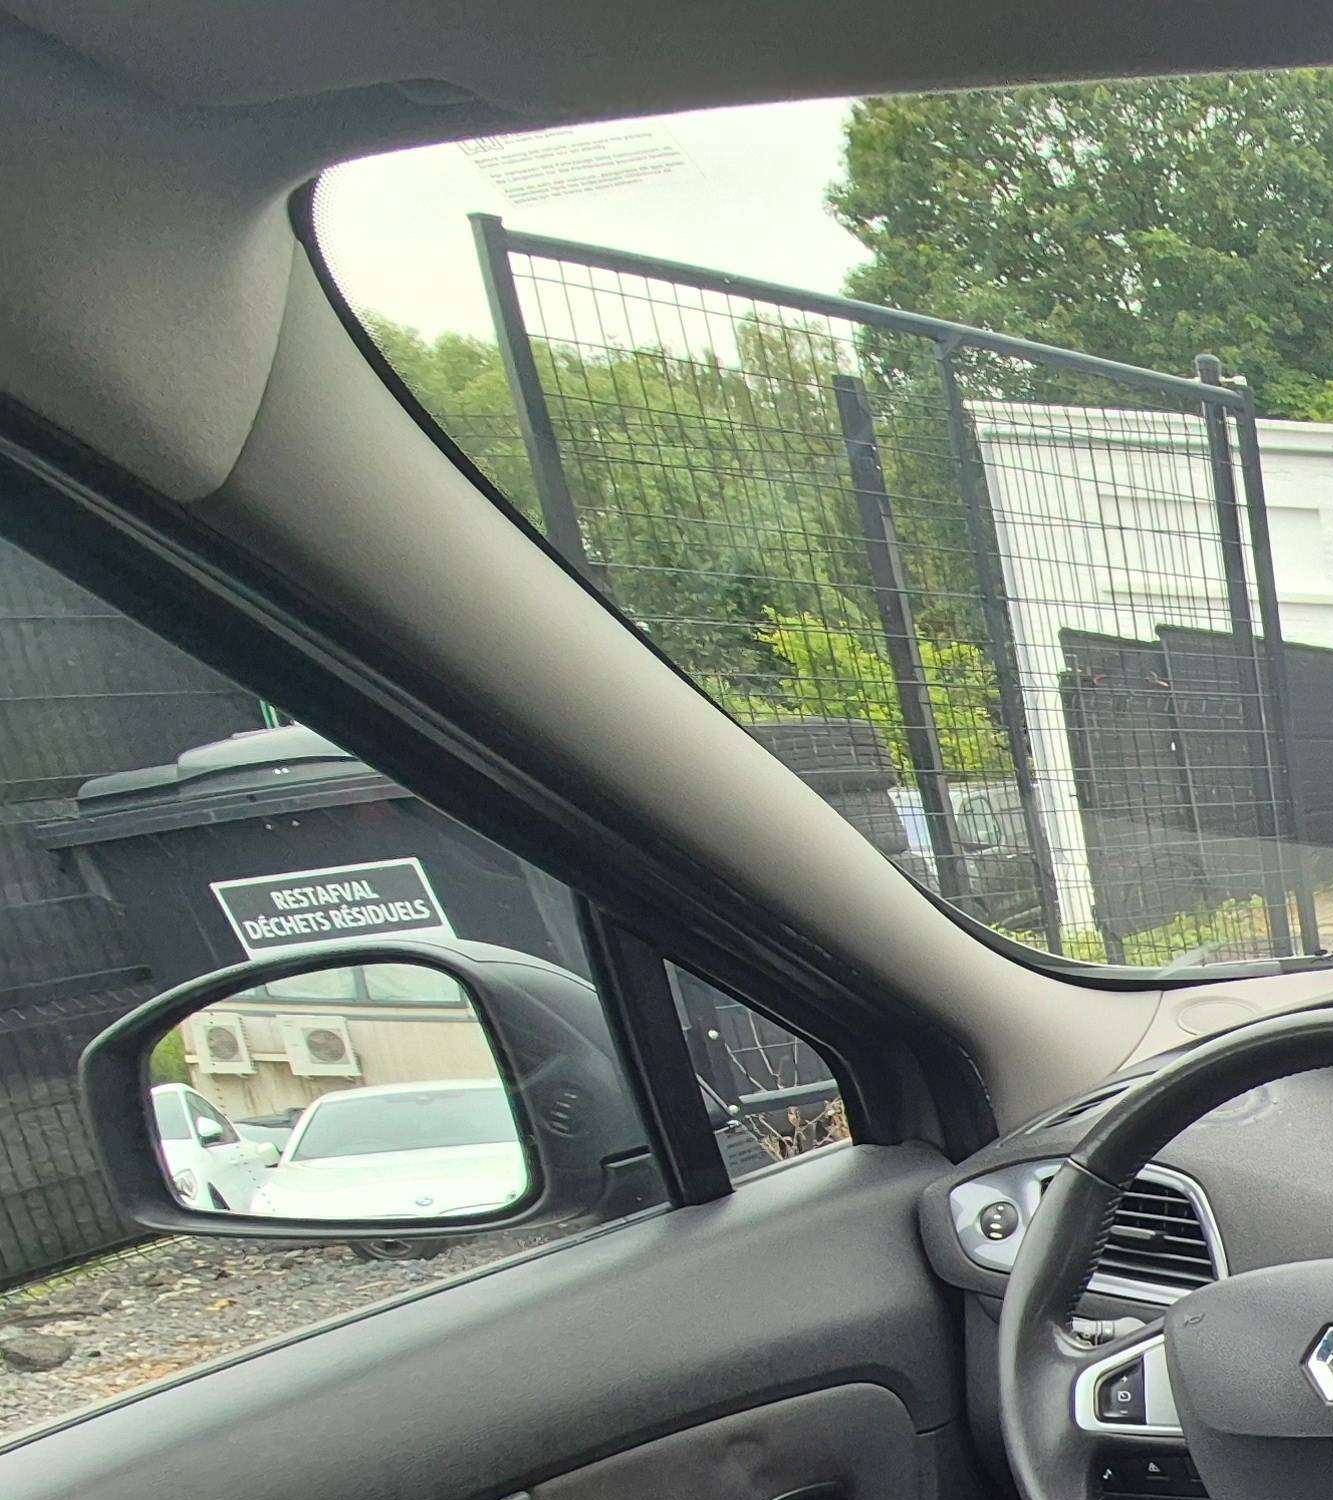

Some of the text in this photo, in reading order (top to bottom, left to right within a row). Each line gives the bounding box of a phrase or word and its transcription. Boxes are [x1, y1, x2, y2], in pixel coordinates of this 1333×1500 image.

[270, 879, 380, 910] RESTAFVAL
[243, 899, 432, 940] DÉCHETS RÉSIDUELS
